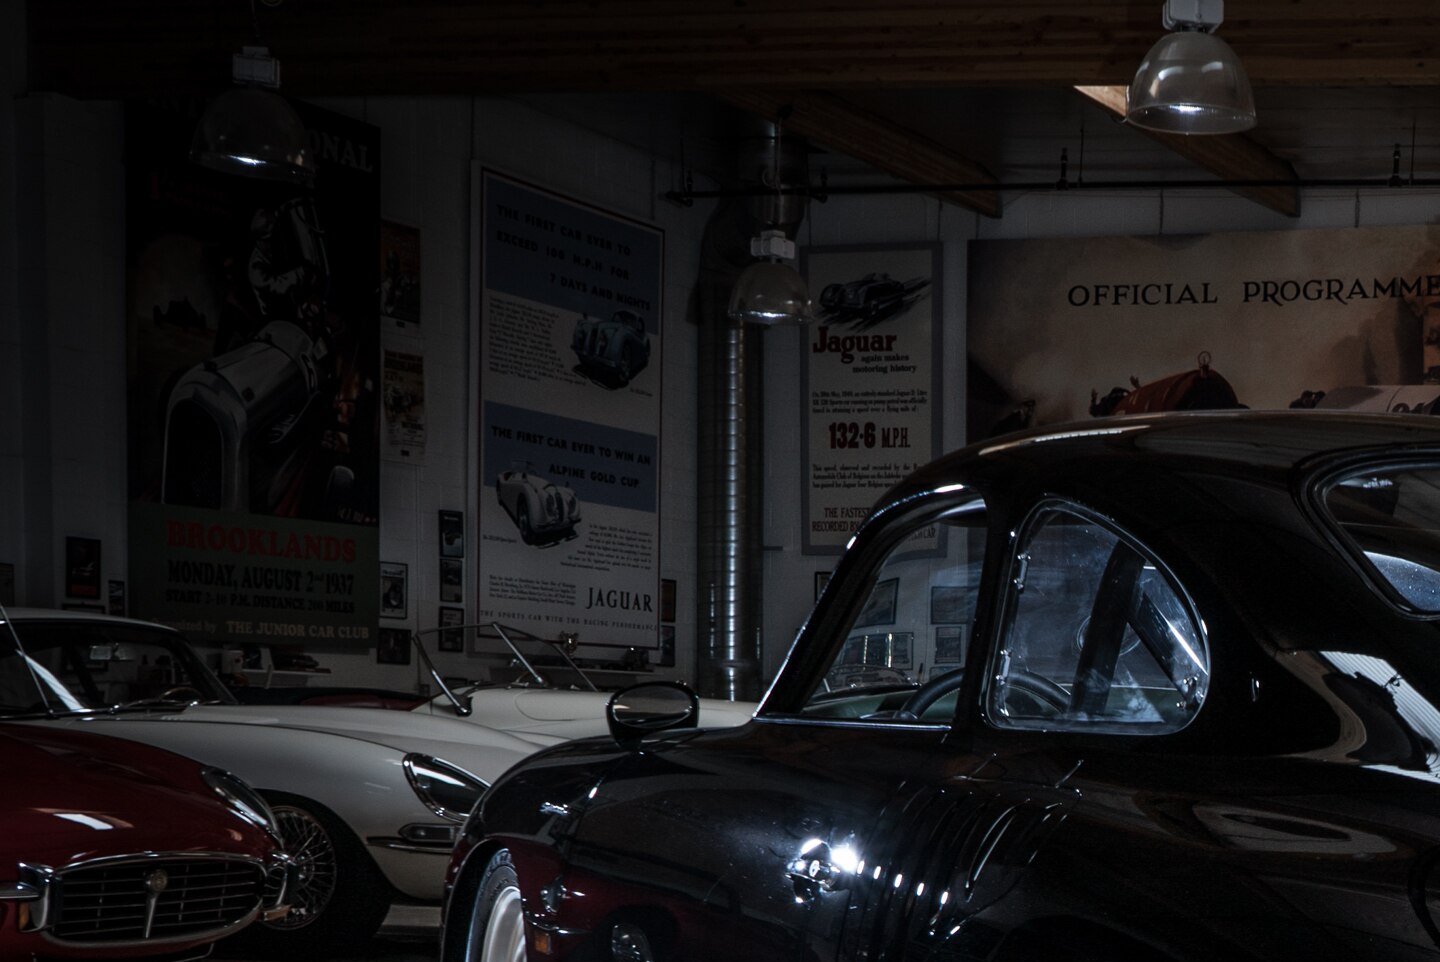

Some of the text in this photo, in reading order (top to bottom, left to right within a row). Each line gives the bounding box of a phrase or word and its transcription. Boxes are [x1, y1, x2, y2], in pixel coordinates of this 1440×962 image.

[496, 204, 632, 257] THE FIRST CAR EVER TO
[496, 230, 539, 252] EXCEED
[546, 245, 565, 260] 100
[610, 266, 630, 281] FOR
[550, 272, 651, 311] 7 DAYS AND NIGHTS
[1067, 283, 1219, 307] OFFICIAL
[812, 326, 897, 364] Jaguar
[852, 364, 917, 374] motoring history
[861, 353, 910, 364] again makes
[490, 425, 651, 465] THE FIRST CAR EVER TO WIN AN
[881, 427, 911, 448] M.P.H.
[549, 463, 640, 489] ALPINE GOLD CUP
[824, 507, 870, 518] THE FASTEST
[811, 521, 849, 532] RECORDED
[166, 519, 357, 564] BROOKLANDS
[167, 559, 238, 591] MONDAY,
[241, 566, 302, 592] AUGUST
[325, 573, 355, 595] 1937
[165, 589, 202, 604] START
[252, 594, 305, 611] DISTANCE
[325, 600, 356, 614] MILES
[585, 587, 653, 613] JAGUAR
[226, 620, 254, 635] THE
[255, 623, 306, 637] JUNIOR
[308, 625, 336, 638] CAR
[338, 626, 370, 639] CLUB
[479, 609, 494, 618] THE
[498, 611, 525, 620] SPORTS
[528, 613, 542, 621] CAR
[545, 615, 563, 623] WITH
[566, 616, 580, 624] THE
[583, 618, 609, 628] RACING
